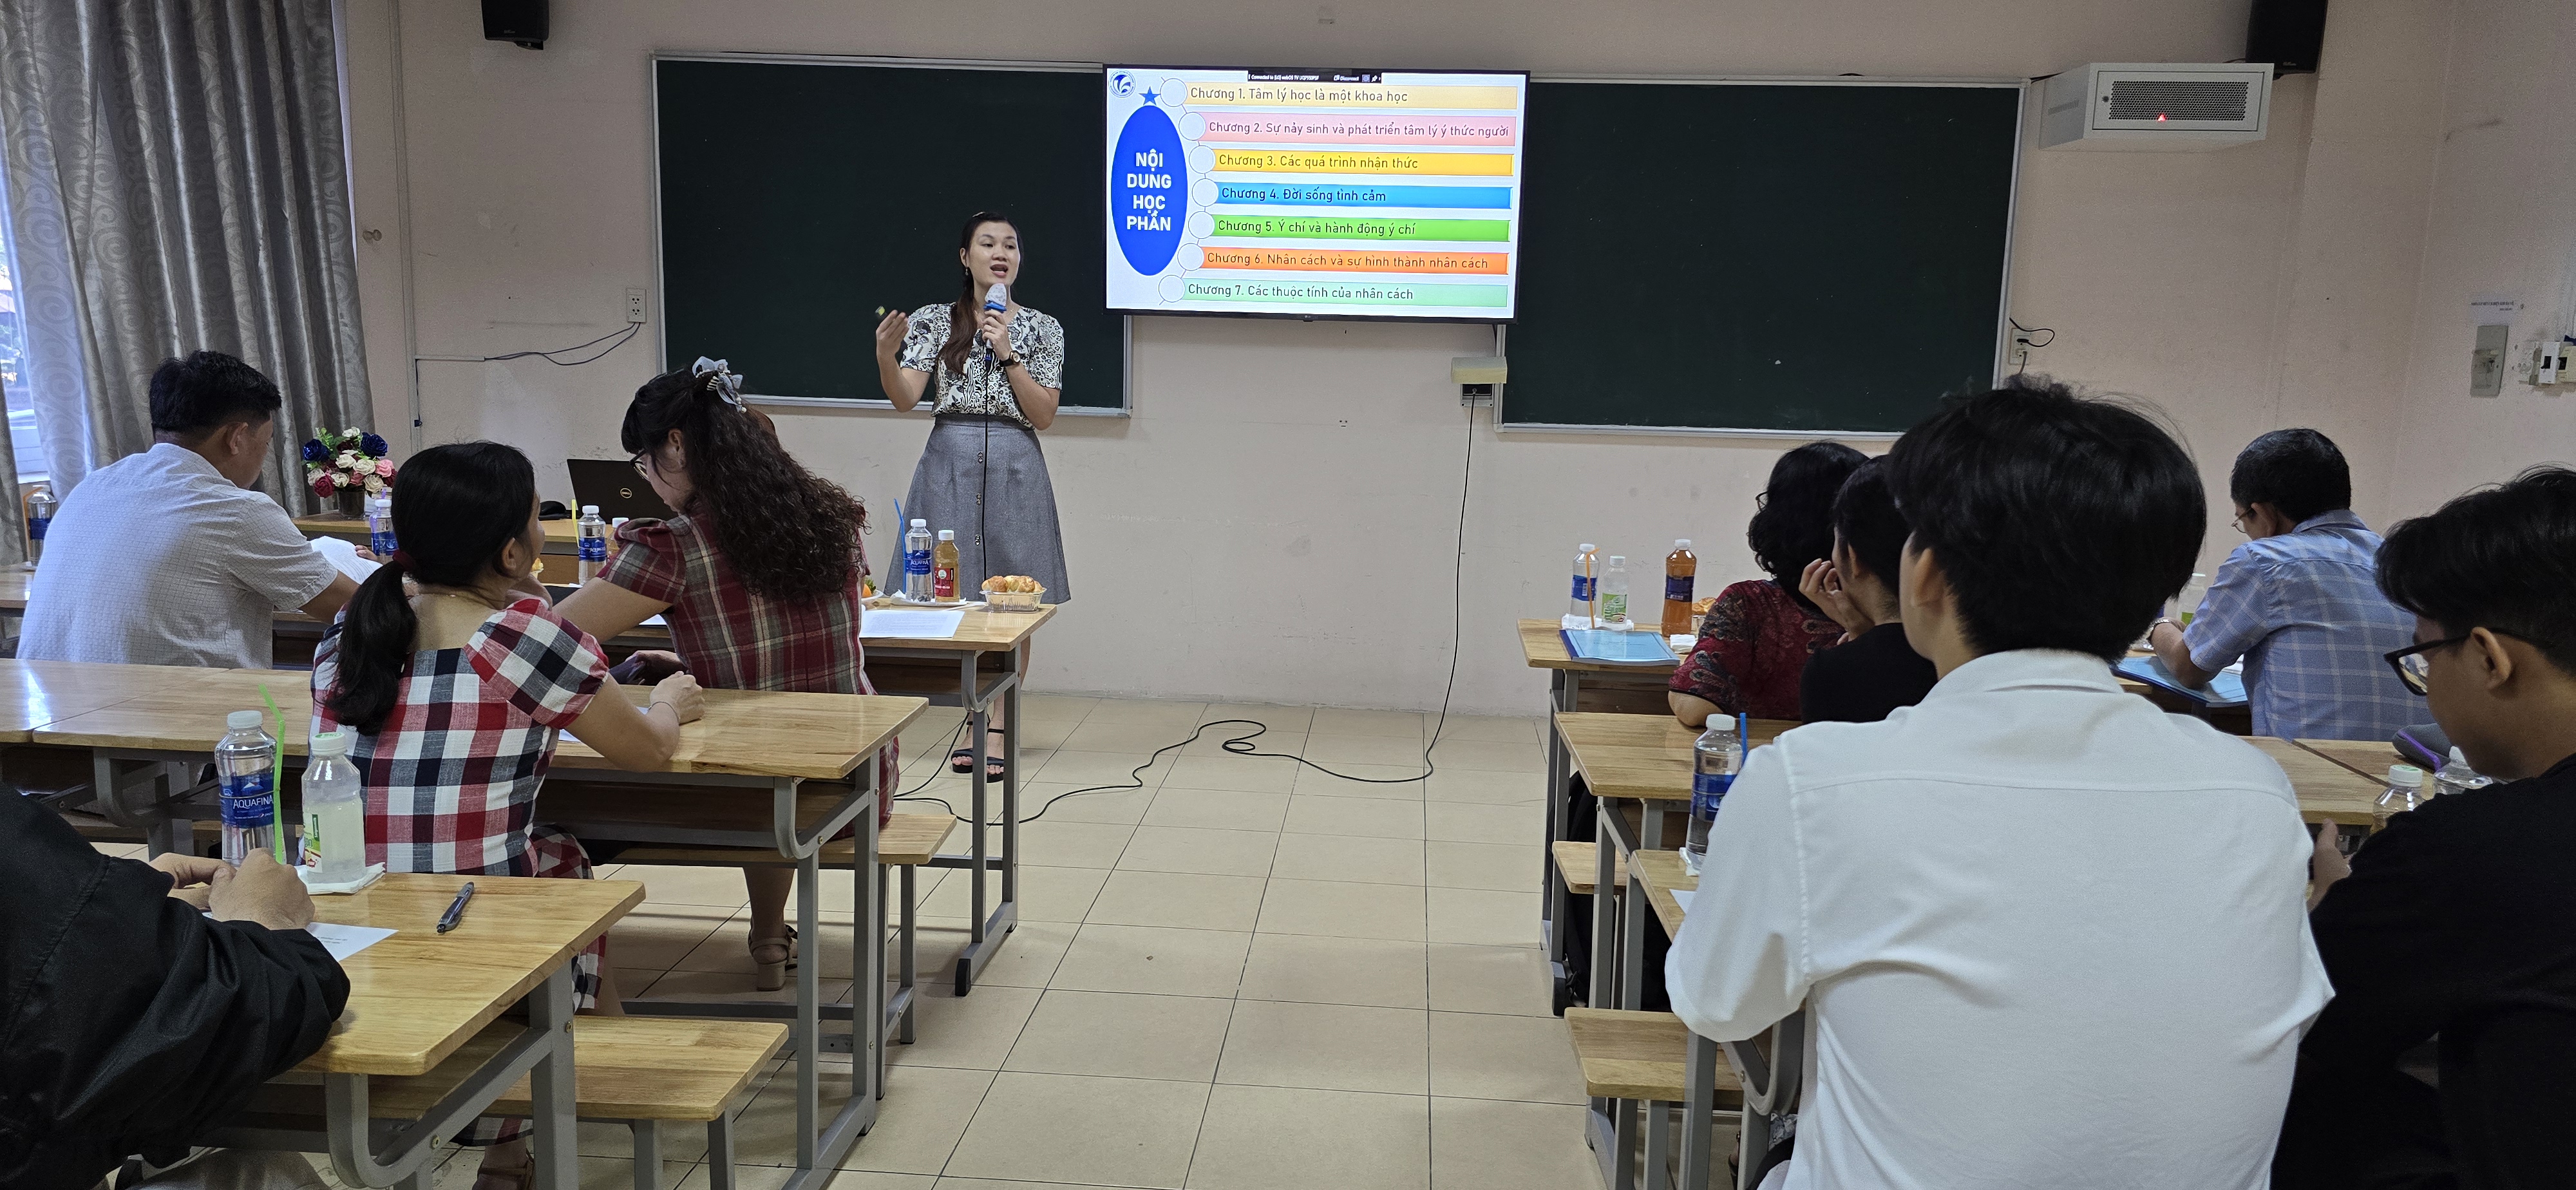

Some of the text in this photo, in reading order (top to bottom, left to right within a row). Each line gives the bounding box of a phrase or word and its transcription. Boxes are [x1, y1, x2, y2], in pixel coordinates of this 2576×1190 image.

[1191, 88, 1407, 104] Chương 1. Tâm lý học là một khoa học
[1209, 121, 1509, 138] Chương 2. Sự nảy sinh và phát triển tâm lý ý thức người
[1135, 148, 1163, 172] NỘI
[1219, 155, 1418, 171] Chương 3. Các quá trình nhận thức
[1127, 173, 1172, 189] DUNG
[1222, 188, 1265, 202] Chương
[1283, 187, 1302, 200] Đời
[1305, 186, 1332, 202] sống
[1336, 189, 1358, 201] tình
[1362, 189, 1386, 202] cảm
[1133, 194, 1166, 214] HỌC
[1218, 218, 1416, 236] Chương 5. Ý chí và hành động ý chí
[1208, 252, 1488, 269] Chương 6. Nhân cách và sự hình thành nhân cách
[1188, 283, 1413, 299] Chương 7. Các thuộc tính của nhân cách
[232, 795, 274, 809] AQUAFINA
